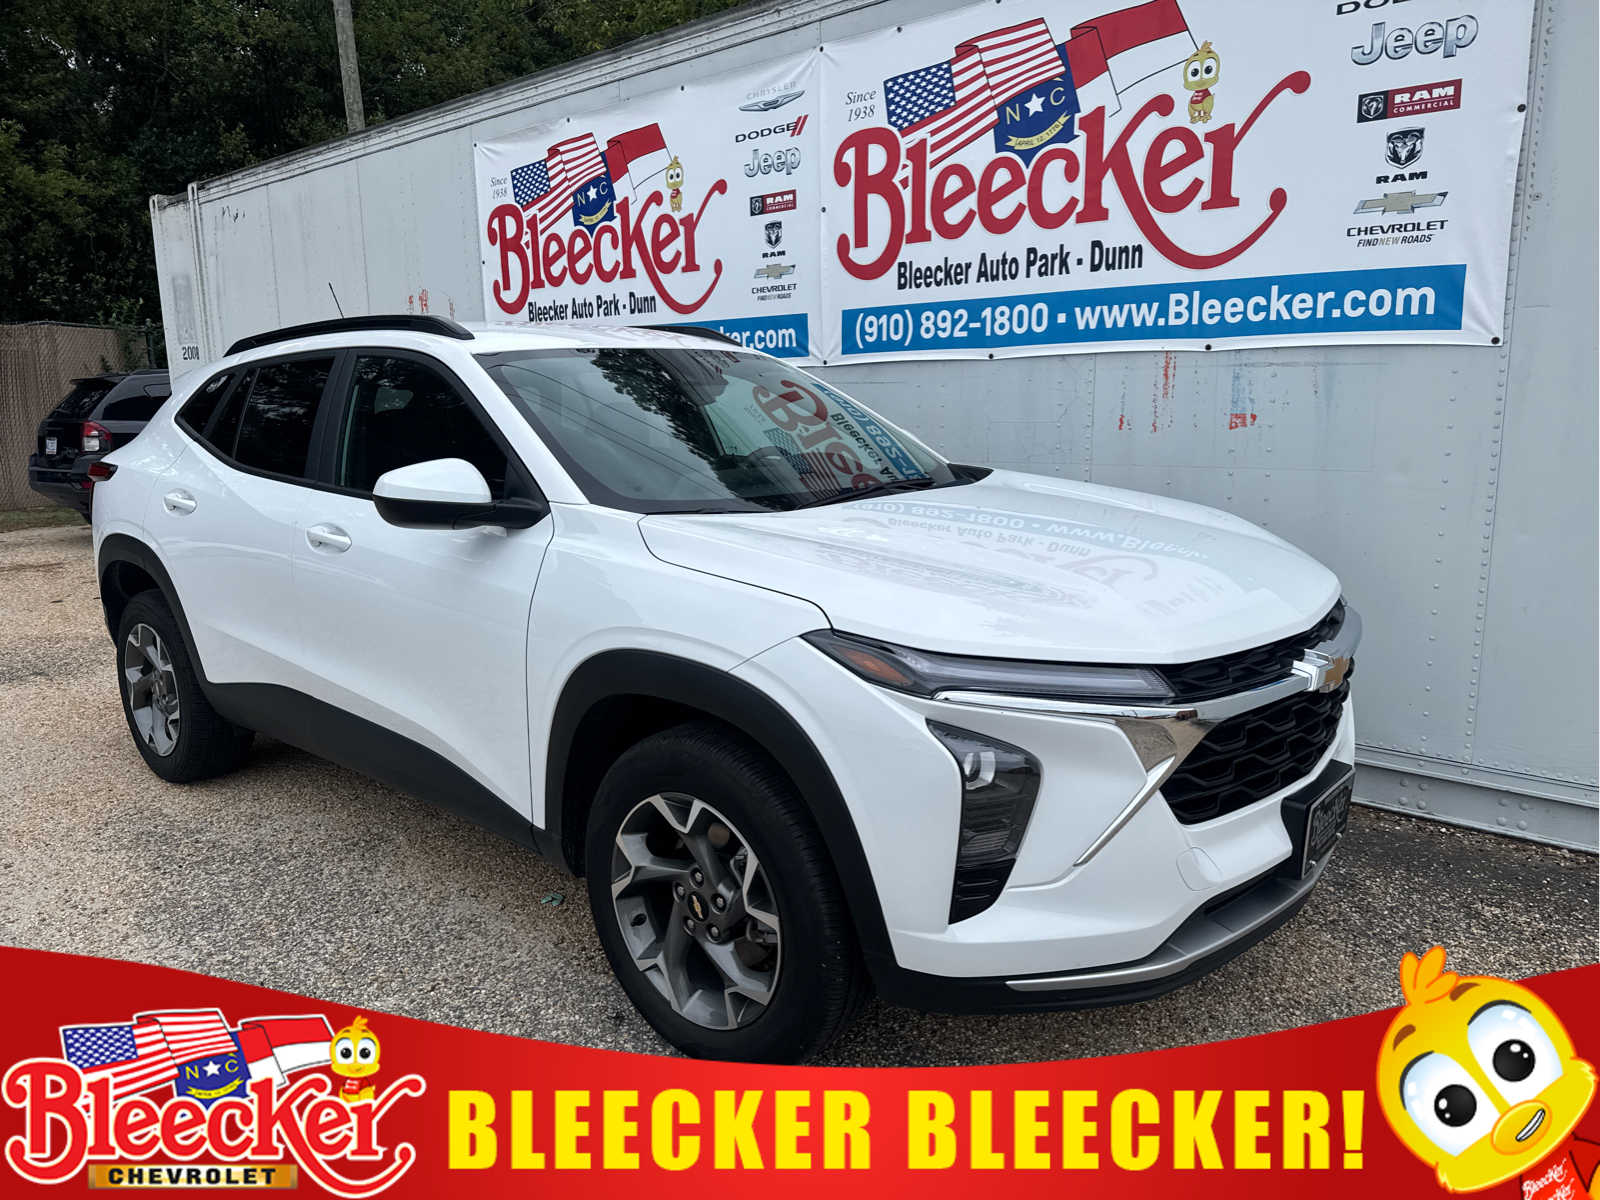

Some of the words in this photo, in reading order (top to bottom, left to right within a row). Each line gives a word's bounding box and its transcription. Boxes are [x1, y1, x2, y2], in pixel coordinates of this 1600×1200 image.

[1350, 15, 1479, 66] Jeep
[845, 90, 877, 105] Since
[1394, 86, 1455, 104] RAM
[848, 104, 876, 122] 1938
[1006, 103, 1021, 125] N
[1049, 87, 1066, 106] C
[1393, 100, 1455, 114] COMMERCIAL
[735, 121, 799, 143] DODGE
[744, 147, 801, 178] Jeep
[833, 70, 1311, 281] Bleecker
[1376, 171, 1428, 184] RAM
[766, 193, 794, 205] RAM
[1346, 219, 1449, 238] CHEVROLET
[487, 178, 728, 315] Bleecker
[762, 249, 786, 259] RAM
[897, 256, 972, 290] Bleecker
[976, 251, 1019, 284] Auto
[1025, 244, 1071, 279] Park
[1090, 239, 1143, 273] Dunn
[751, 283, 797, 295] CHEVROLET
[528, 299, 569, 323] Bleecker
[571, 297, 594, 320] Auto
[596, 293, 621, 318] Park
[629, 291, 657, 315] Dunn
[855, 309, 914, 349] (910)
[920, 302, 1049, 340] 892-1800
[1073, 284, 1436, 331] www.Bleecker.com
